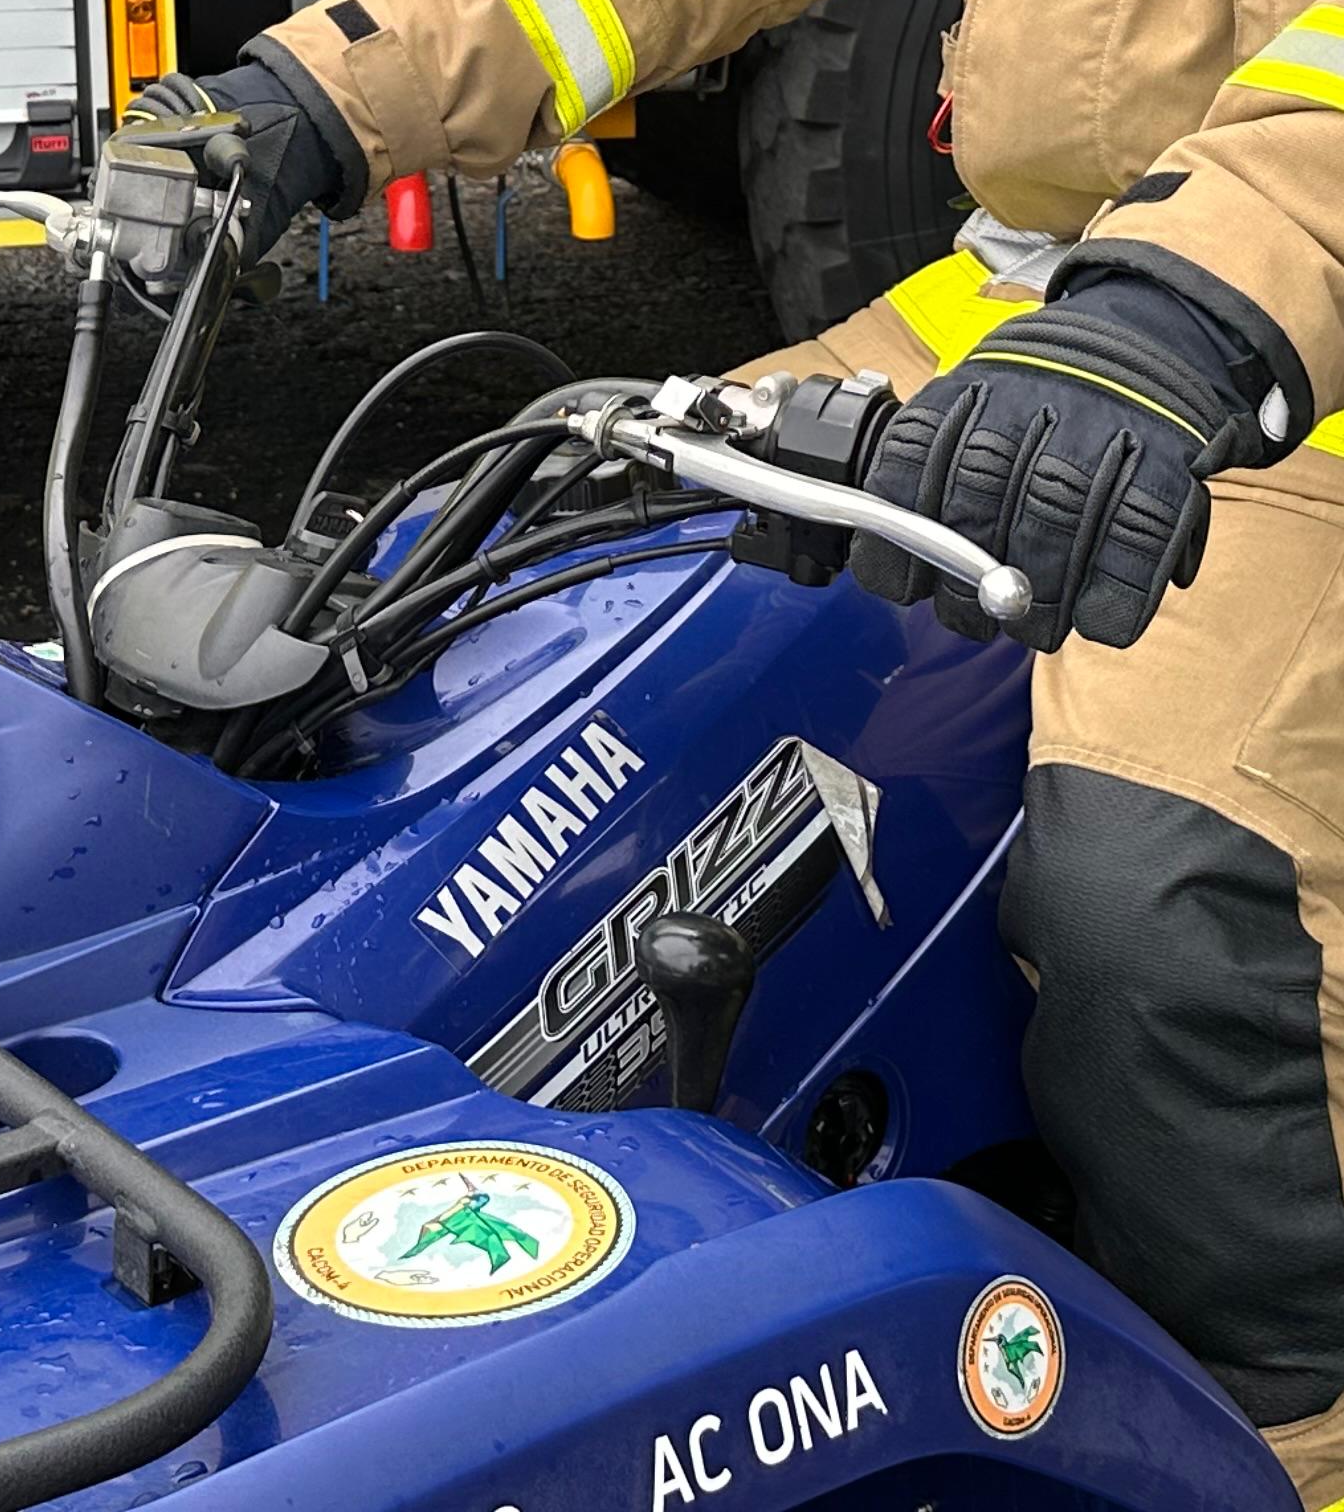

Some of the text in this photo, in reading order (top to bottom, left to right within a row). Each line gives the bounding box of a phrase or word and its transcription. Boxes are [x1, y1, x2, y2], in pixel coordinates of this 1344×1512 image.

[417, 721, 645, 959] YAMAHA
[401, 1155, 550, 1175] DEPARTAMENTO
[549, 1167, 573, 1185] DE
[306, 1246, 352, 1292] CACOM-4
[500, 1236, 602, 1300] OPERACIONAL
[748, 1348, 889, 1466] ONA
